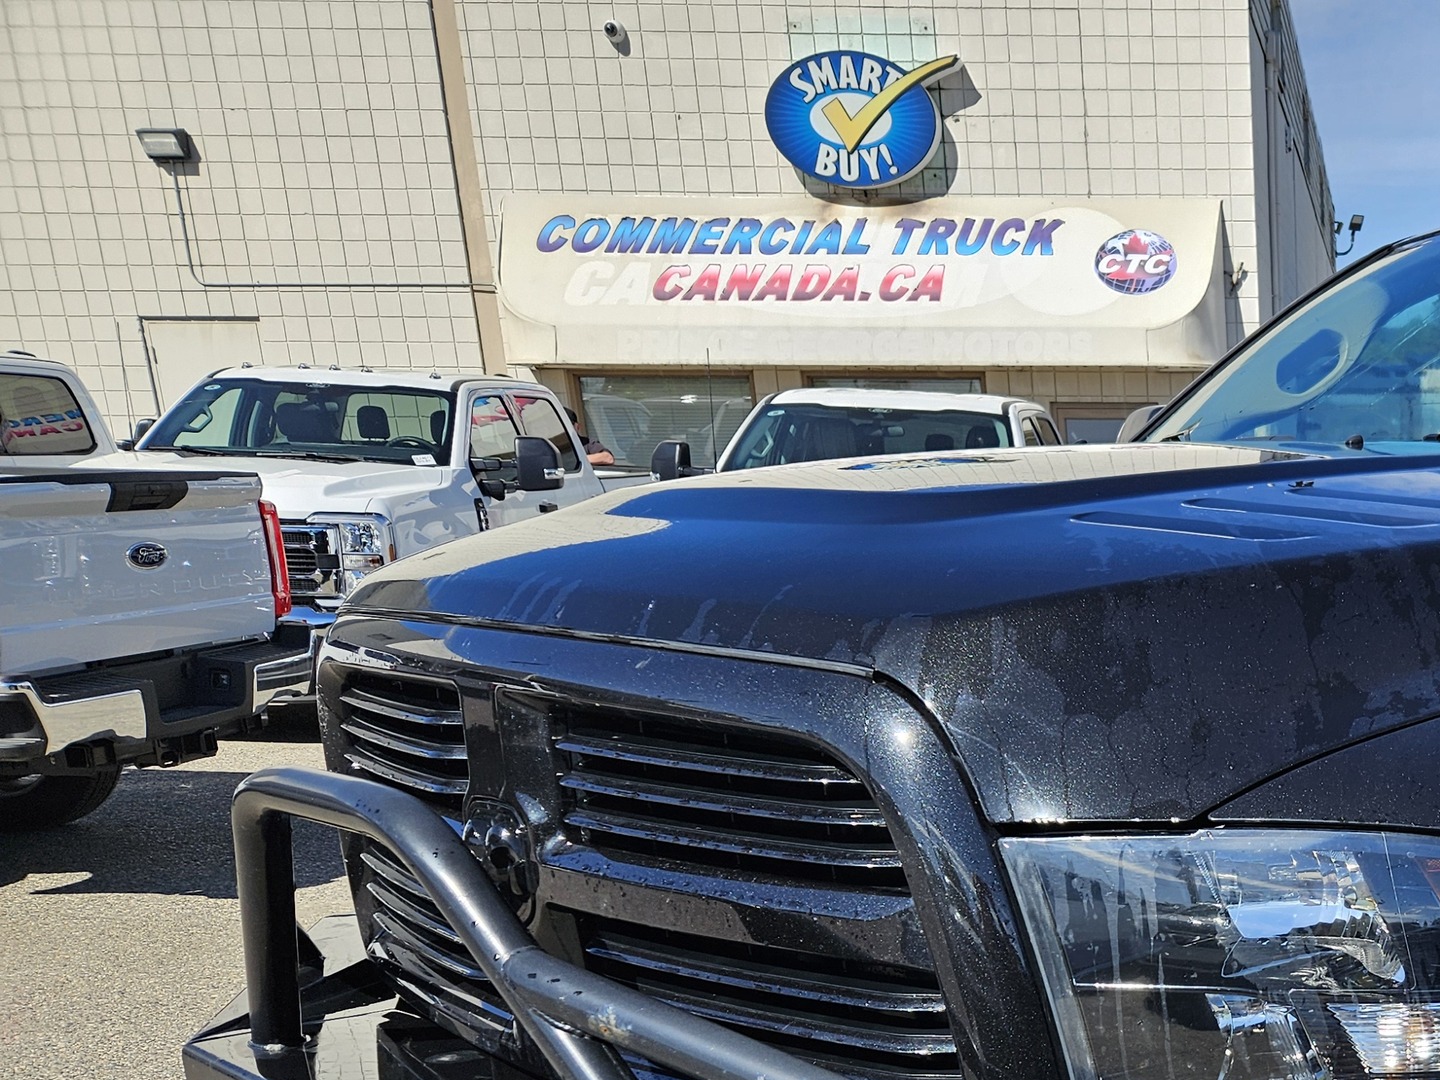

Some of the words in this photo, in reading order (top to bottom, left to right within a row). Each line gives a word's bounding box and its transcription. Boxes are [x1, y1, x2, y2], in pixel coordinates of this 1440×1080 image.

[789, 55, 904, 104] SMART
[814, 143, 899, 182] BUY!
[536, 214, 871, 255] COMMERCIAL
[892, 216, 1066, 256] TRUCK
[652, 263, 947, 302] CANADA.CA
[1098, 253, 1171, 275] CTC
